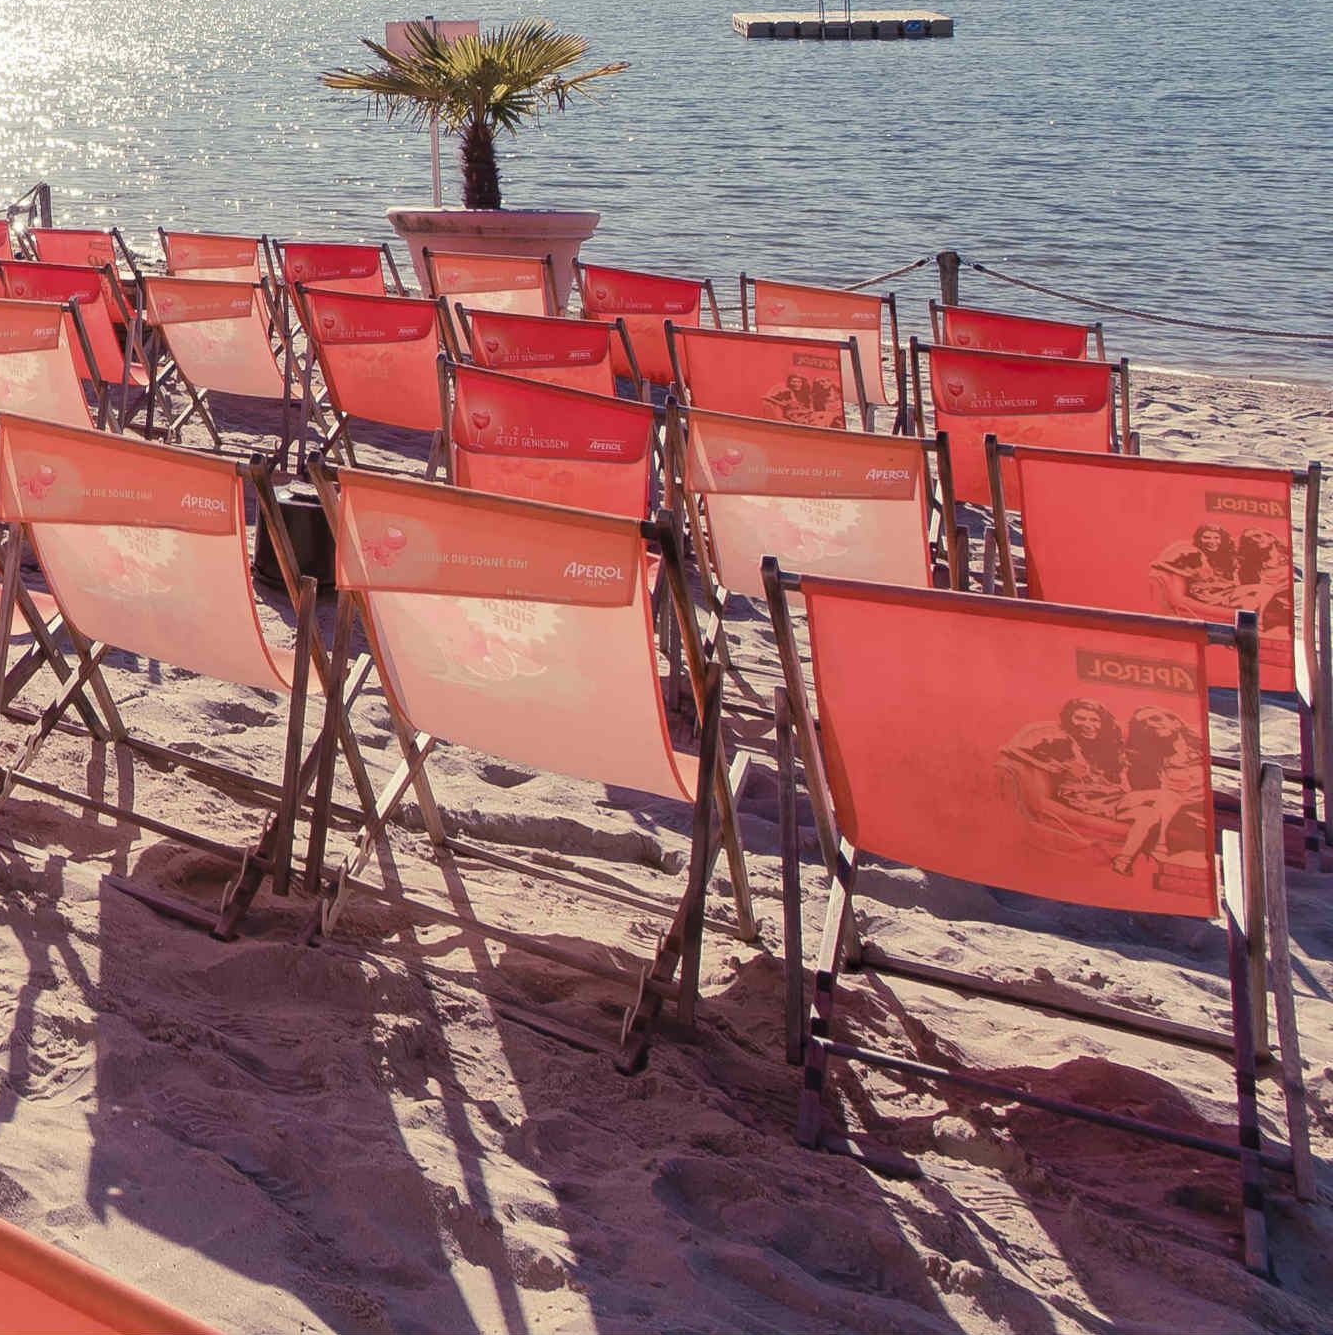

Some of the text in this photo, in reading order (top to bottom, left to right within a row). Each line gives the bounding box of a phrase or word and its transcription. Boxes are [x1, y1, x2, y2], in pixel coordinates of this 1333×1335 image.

[863, 467, 911, 481] APEROL
[180, 493, 228, 514] APEROL
[562, 561, 626, 581] APEROL
